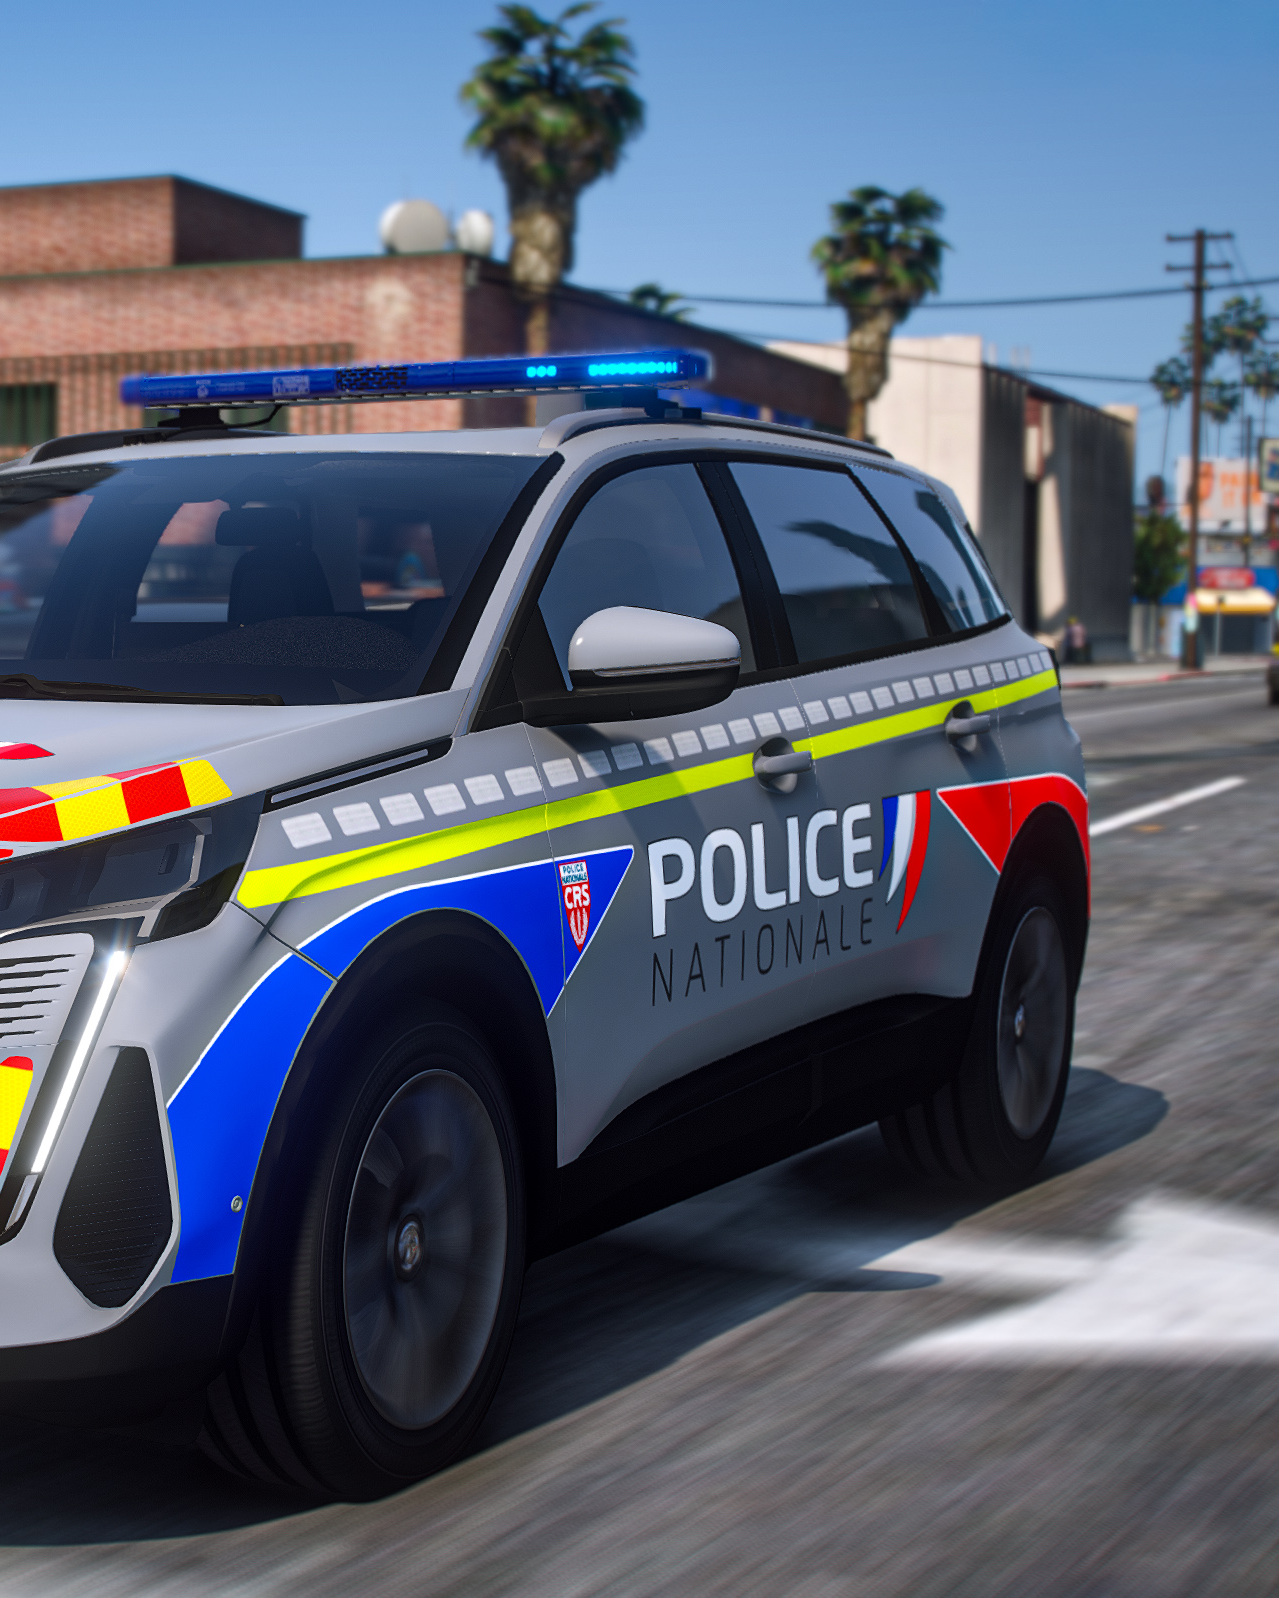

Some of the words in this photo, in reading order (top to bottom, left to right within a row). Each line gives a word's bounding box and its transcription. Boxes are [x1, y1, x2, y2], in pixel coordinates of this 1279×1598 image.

[562, 863, 584, 874] POLICE
[564, 883, 590, 909] CRS
[646, 802, 874, 938] POLICE
[651, 898, 874, 1007] NATIONALE
